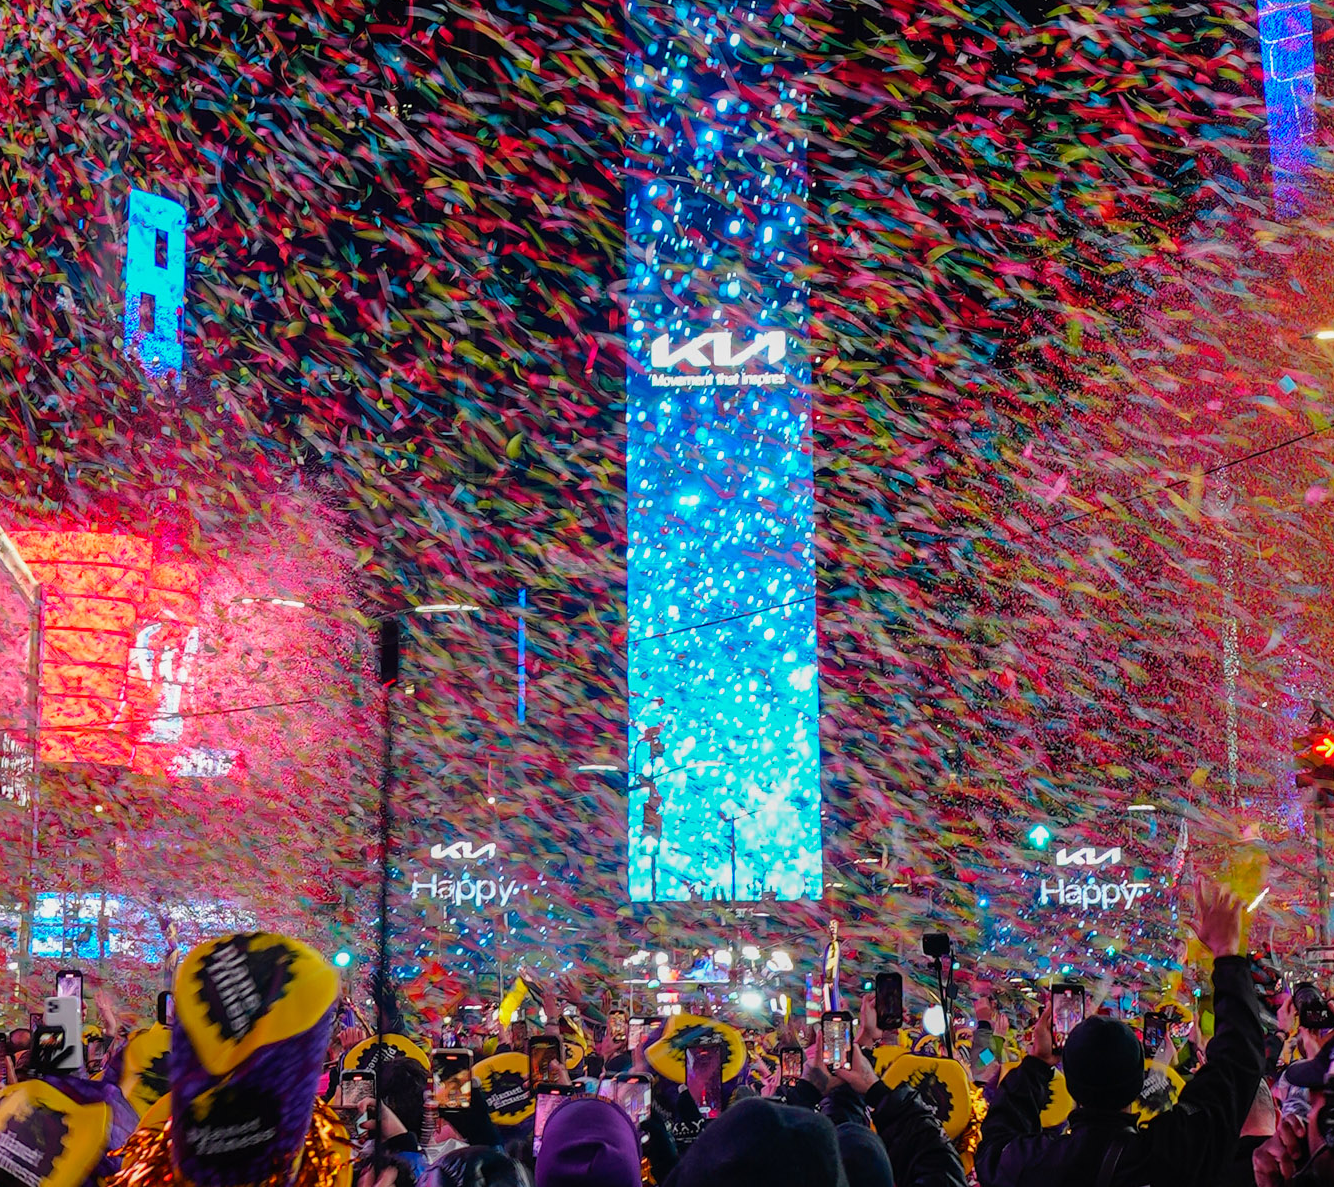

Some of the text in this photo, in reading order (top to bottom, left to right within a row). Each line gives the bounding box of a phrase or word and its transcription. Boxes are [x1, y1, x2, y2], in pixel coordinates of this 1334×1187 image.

[651, 331, 787, 368] KIA
[651, 371, 787, 388] Movement that inspires
[410, 873, 517, 907] Happy
[1040, 878, 1139, 911] Happy
